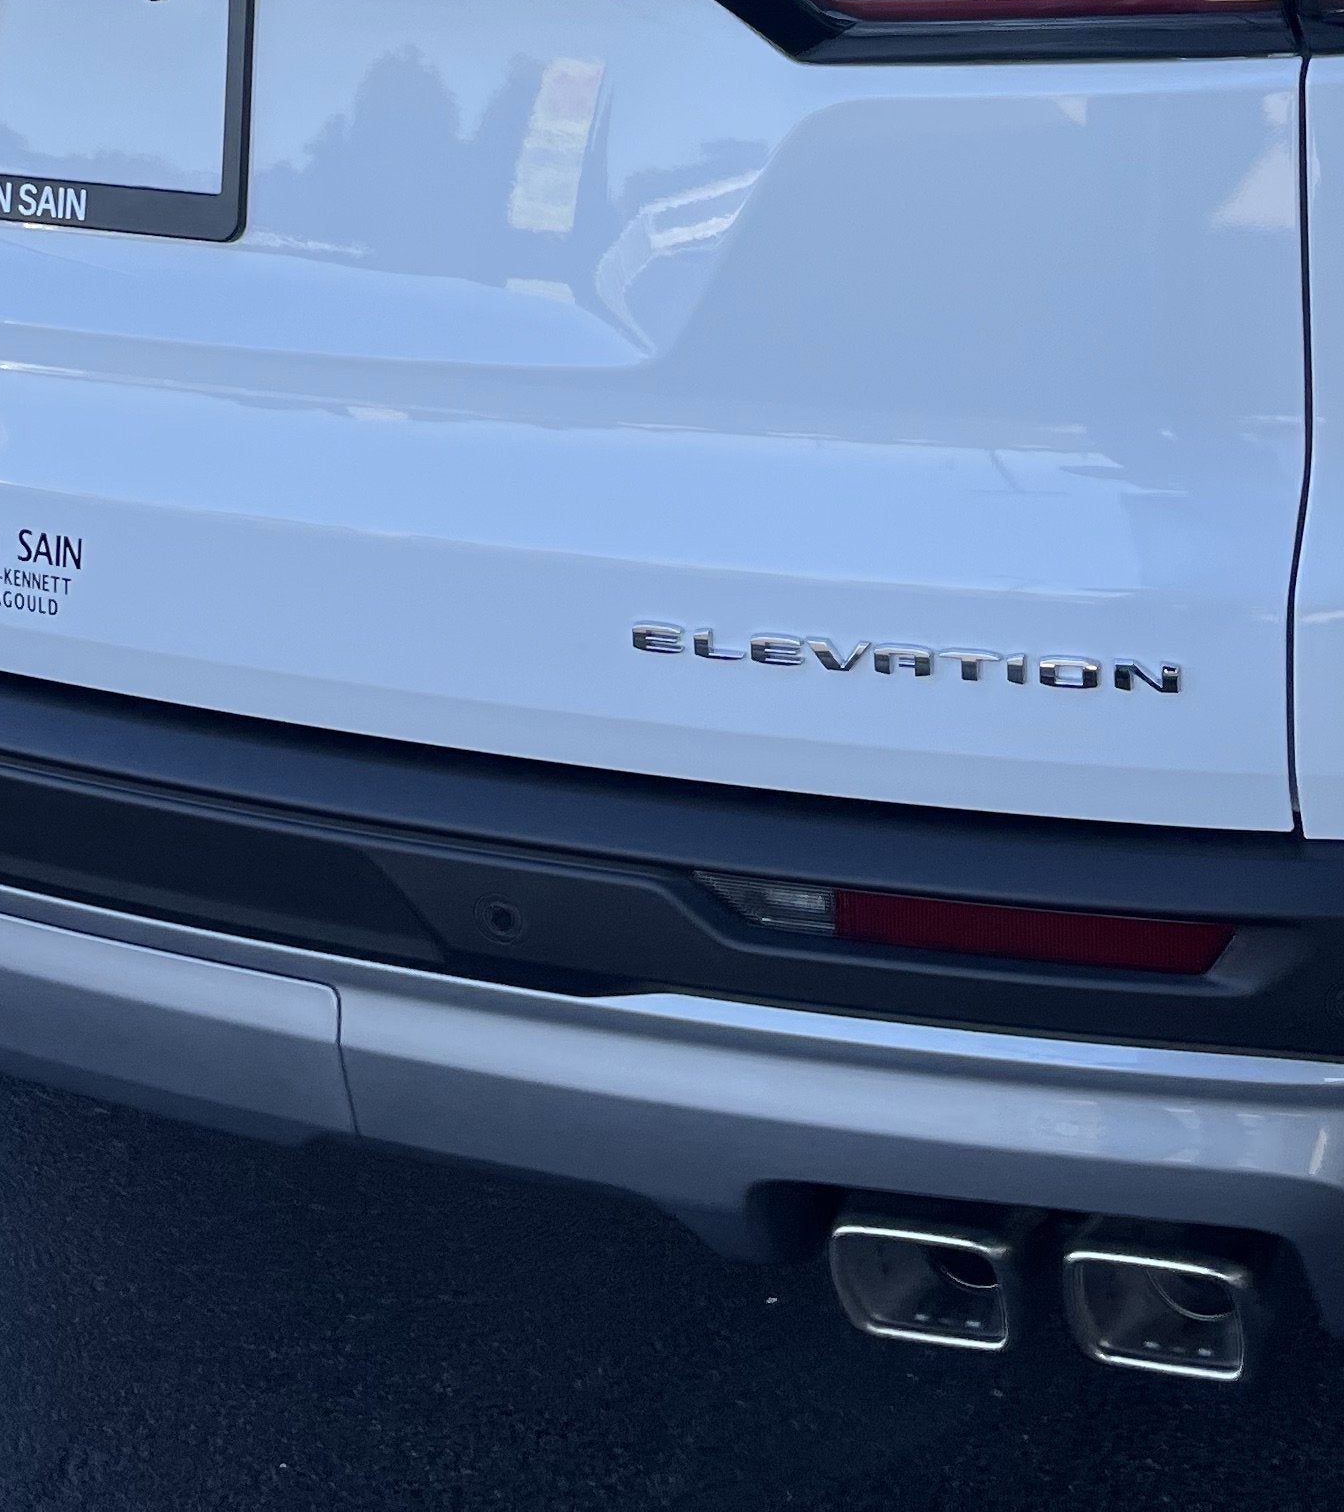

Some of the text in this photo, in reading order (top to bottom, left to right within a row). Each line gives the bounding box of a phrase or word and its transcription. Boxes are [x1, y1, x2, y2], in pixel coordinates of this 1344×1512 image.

[17, 183, 87, 220] SAIN
[17, 528, 83, 570] SAIN
[632, 620, 1182, 694] ELEVATION
